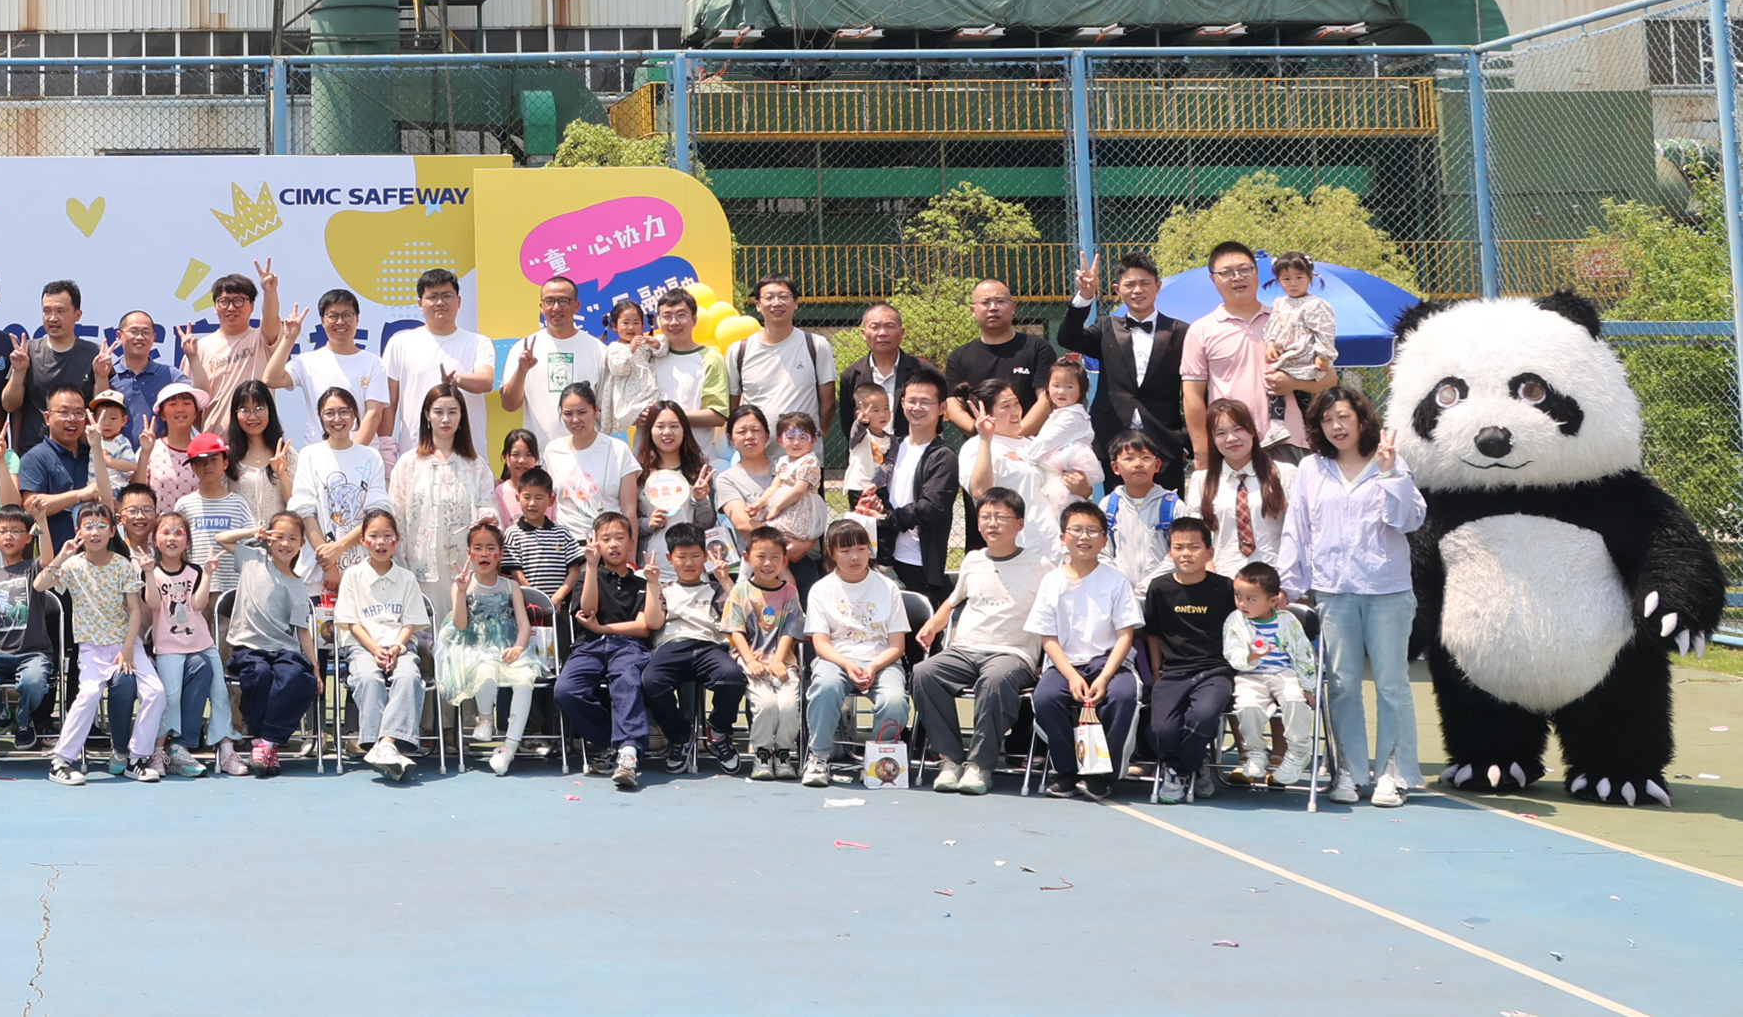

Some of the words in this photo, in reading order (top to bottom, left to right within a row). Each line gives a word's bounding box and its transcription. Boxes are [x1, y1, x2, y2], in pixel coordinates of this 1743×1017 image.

[279, 188, 341, 205] CIMC
[348, 187, 470, 205] SAFEWAY
[197, 518, 230, 527] CITYBOY
